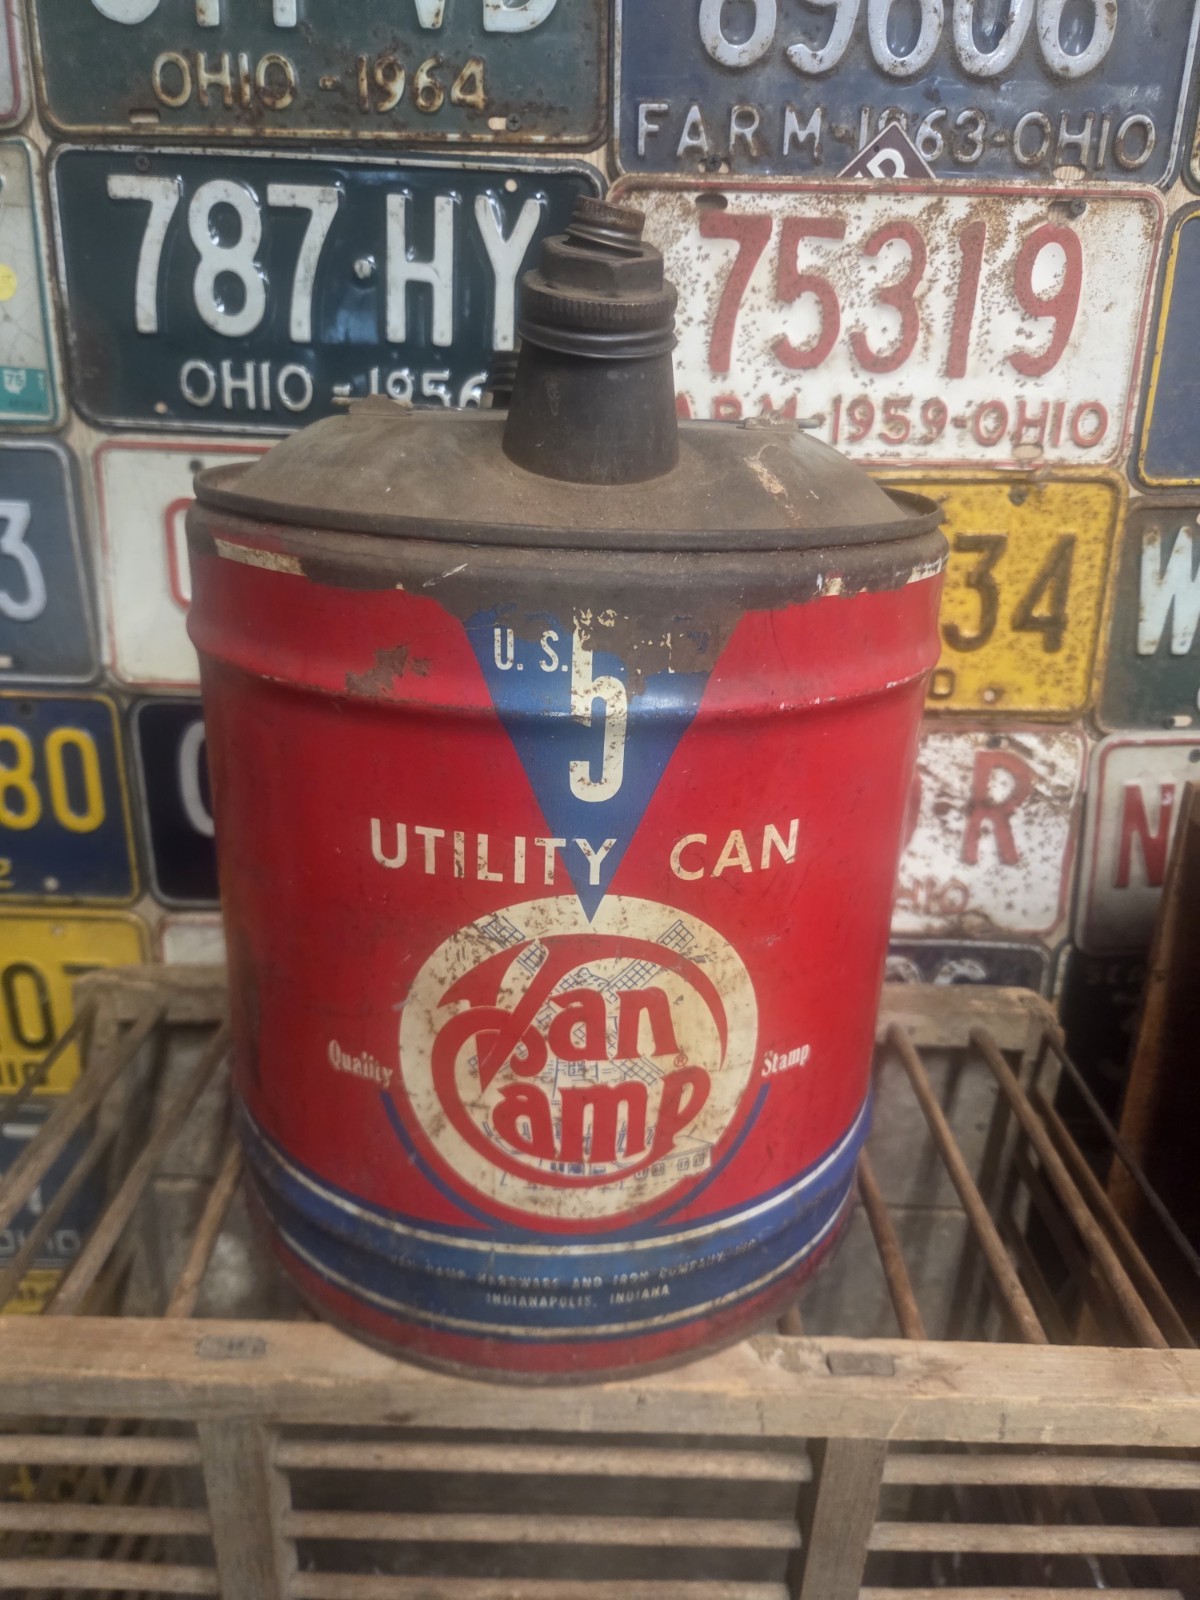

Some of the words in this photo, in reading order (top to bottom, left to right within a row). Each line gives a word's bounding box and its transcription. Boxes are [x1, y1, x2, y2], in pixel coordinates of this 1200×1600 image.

[152, 51, 296, 110] OHIO
[357, 54, 487, 113] 1964
[698, 211, 1084, 380] 75319
[180, 358, 314, 412] OHIO
[940, 532, 1077, 654] 34
[369, 817, 618, 886] UTILITY
[669, 818, 800, 882] CAN
[326, 1038, 394, 1088] Quality
[760, 1041, 811, 1078] Stamp
